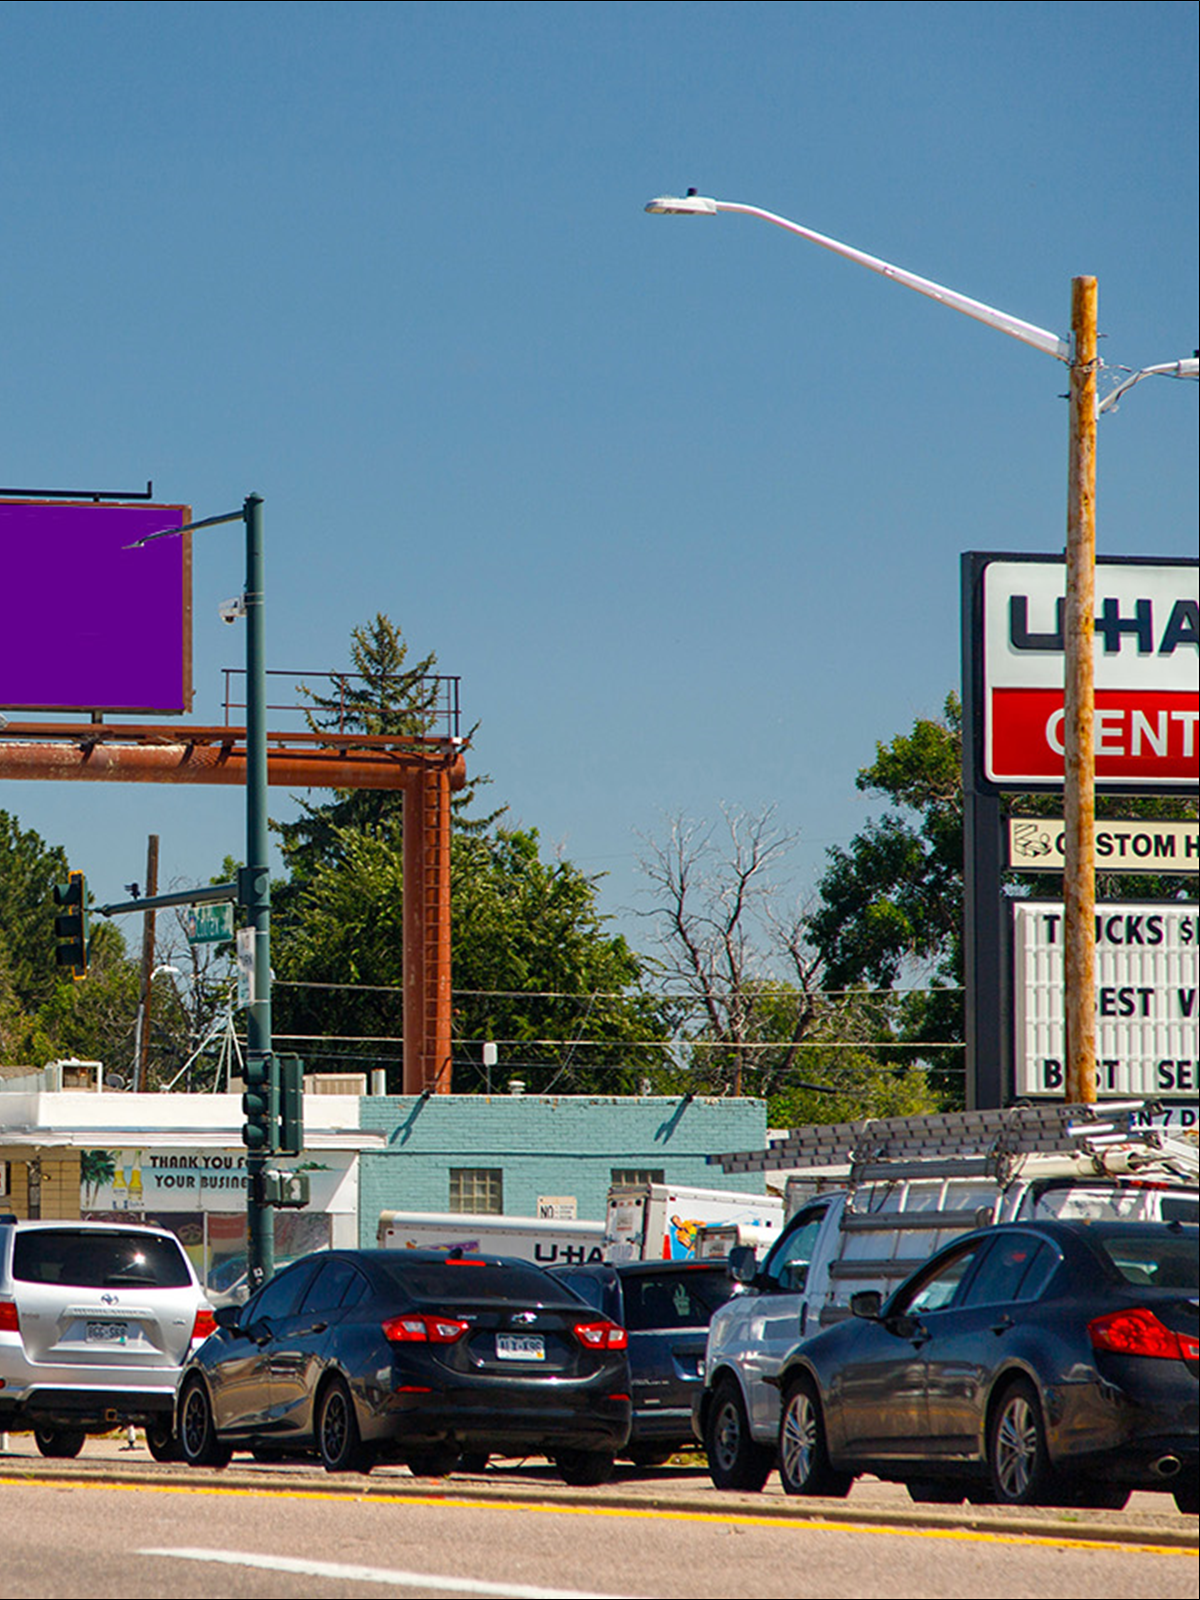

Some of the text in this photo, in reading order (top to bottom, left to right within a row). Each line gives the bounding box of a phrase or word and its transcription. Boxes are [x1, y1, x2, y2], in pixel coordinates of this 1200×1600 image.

[1055, 832, 1175, 857] STOM
[1043, 914, 1164, 945] TCKS
[1094, 986, 1199, 1018] EST V
[1043, 1059, 1199, 1090] BT SE
[150, 1155, 198, 1169] THANK
[202, 1156, 233, 1170] YOU
[154, 1175, 249, 1189] YOUR BUSINE
[534, 1243, 604, 1266] U-HA
